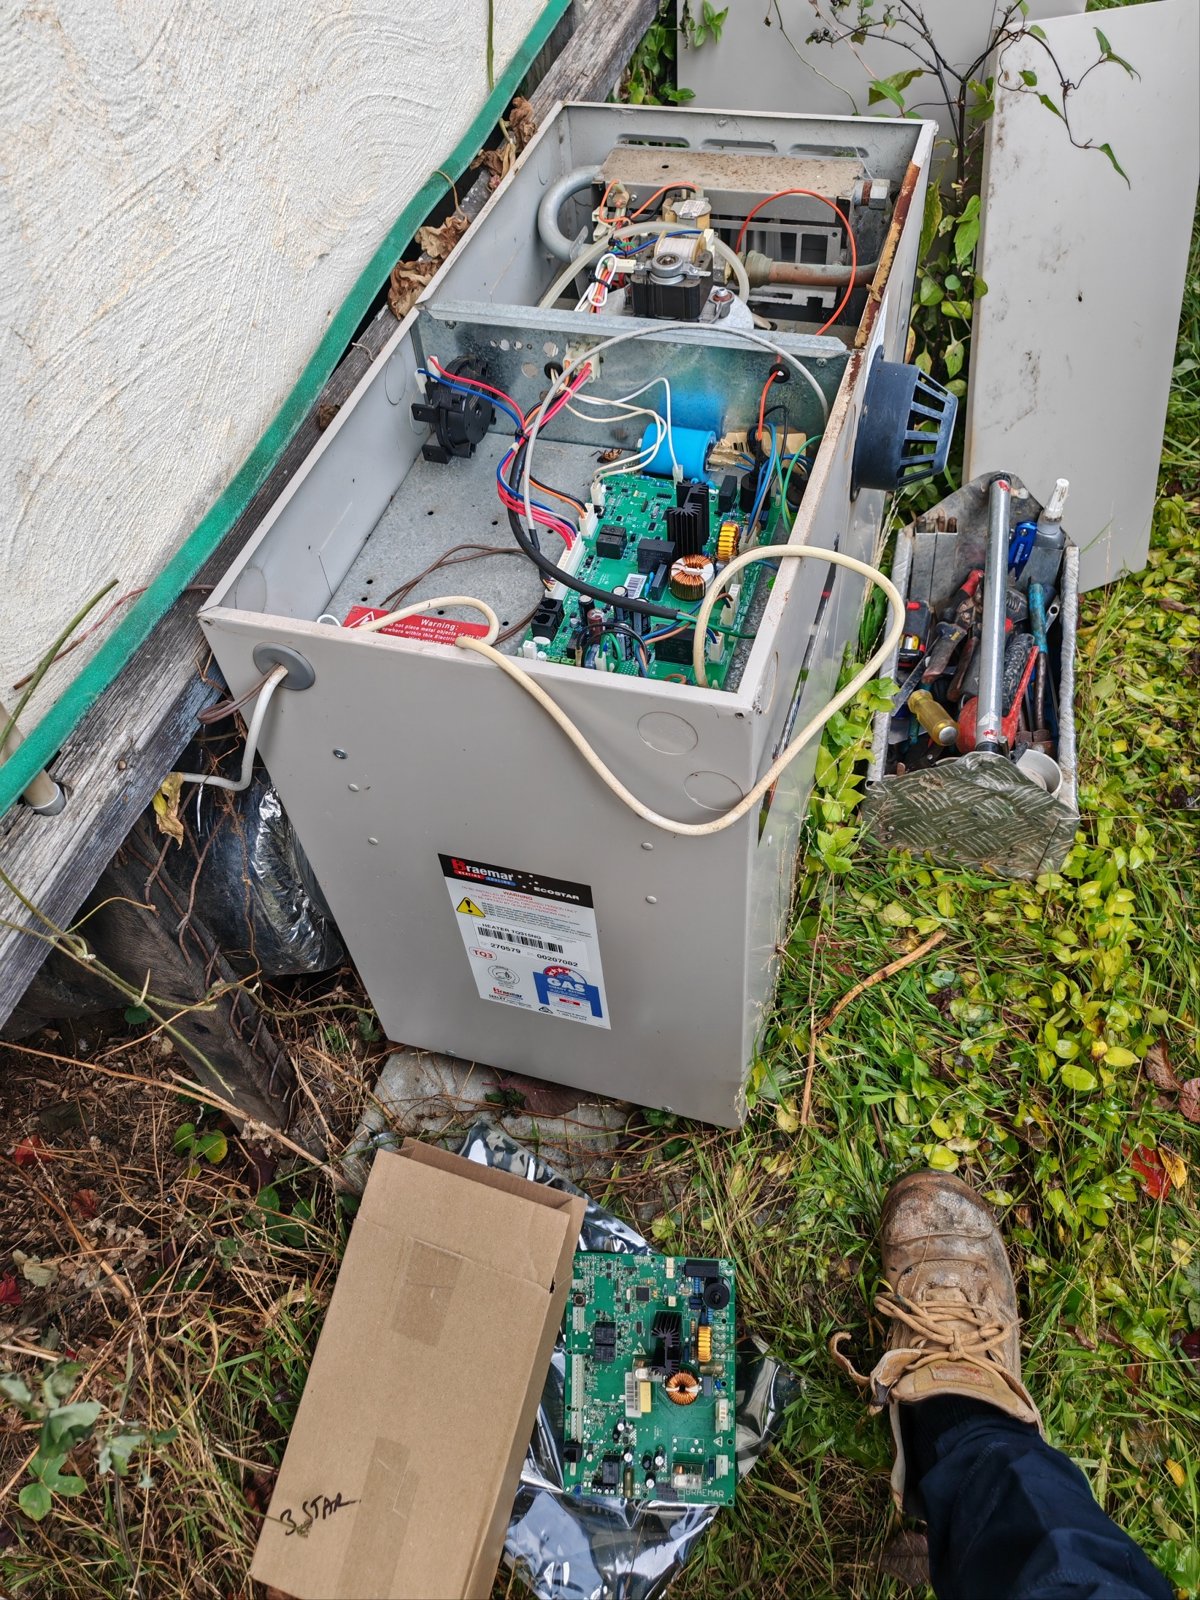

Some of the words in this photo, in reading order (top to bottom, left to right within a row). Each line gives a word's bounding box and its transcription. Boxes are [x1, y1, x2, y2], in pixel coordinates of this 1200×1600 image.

[421, 619, 459, 631] Warning:
[405, 629, 423, 637] within
[451, 858, 514, 881] Braemar
[502, 890, 533, 901] WARNING
[533, 886, 580, 901] ECOSTAR
[481, 922, 510, 933] HEATER
[473, 949, 493, 959] TQ3
[490, 942, 521, 954] 270579
[536, 953, 578, 968] 00207082
[547, 977, 586, 992] GAS
[685, 1488, 725, 1499] BRAEMAR
